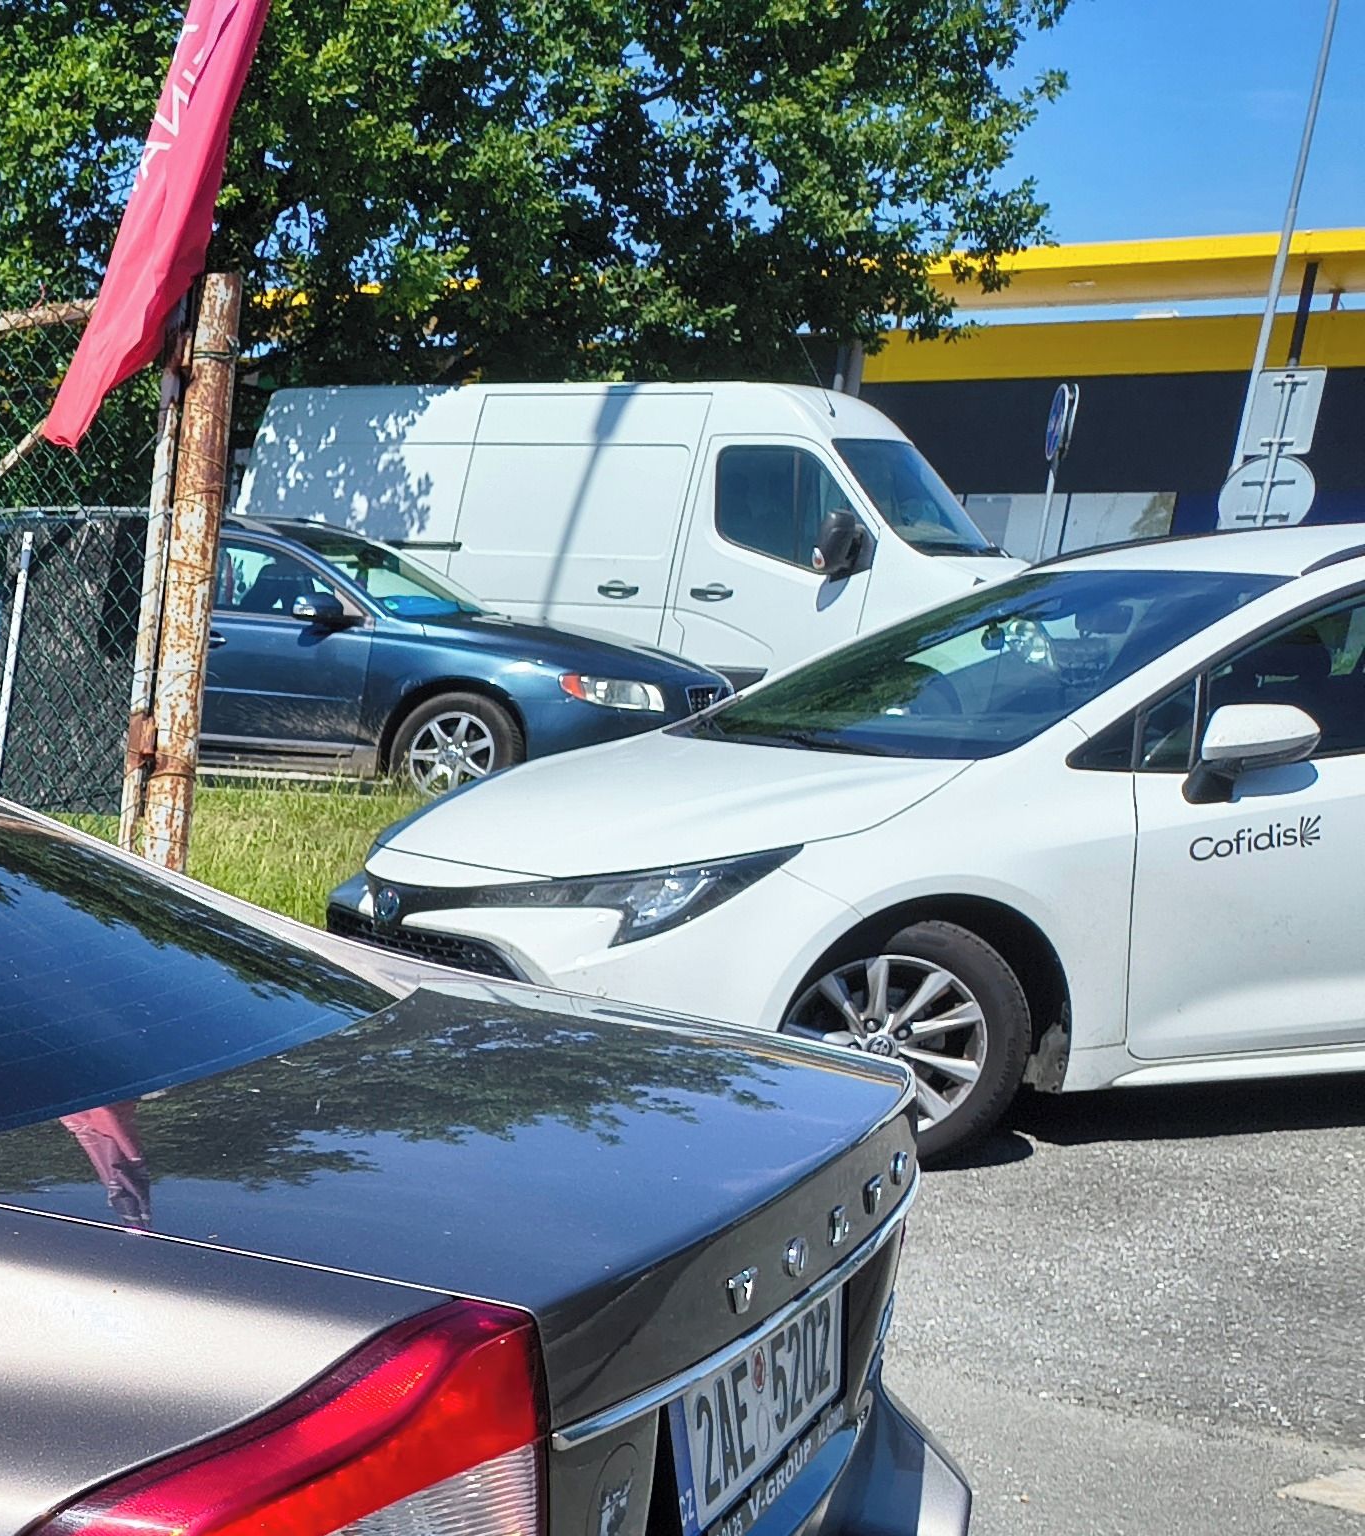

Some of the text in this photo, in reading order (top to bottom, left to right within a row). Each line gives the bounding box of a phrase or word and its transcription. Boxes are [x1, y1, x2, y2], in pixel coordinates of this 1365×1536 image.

[1189, 822, 1298, 861] Cofidis
[726, 1151, 908, 1315] VOLVO
[696, 1299, 831, 1506] 2AE 5202
[679, 1488, 696, 1528] CZ
[748, 1438, 812, 1521] V-GROUP
